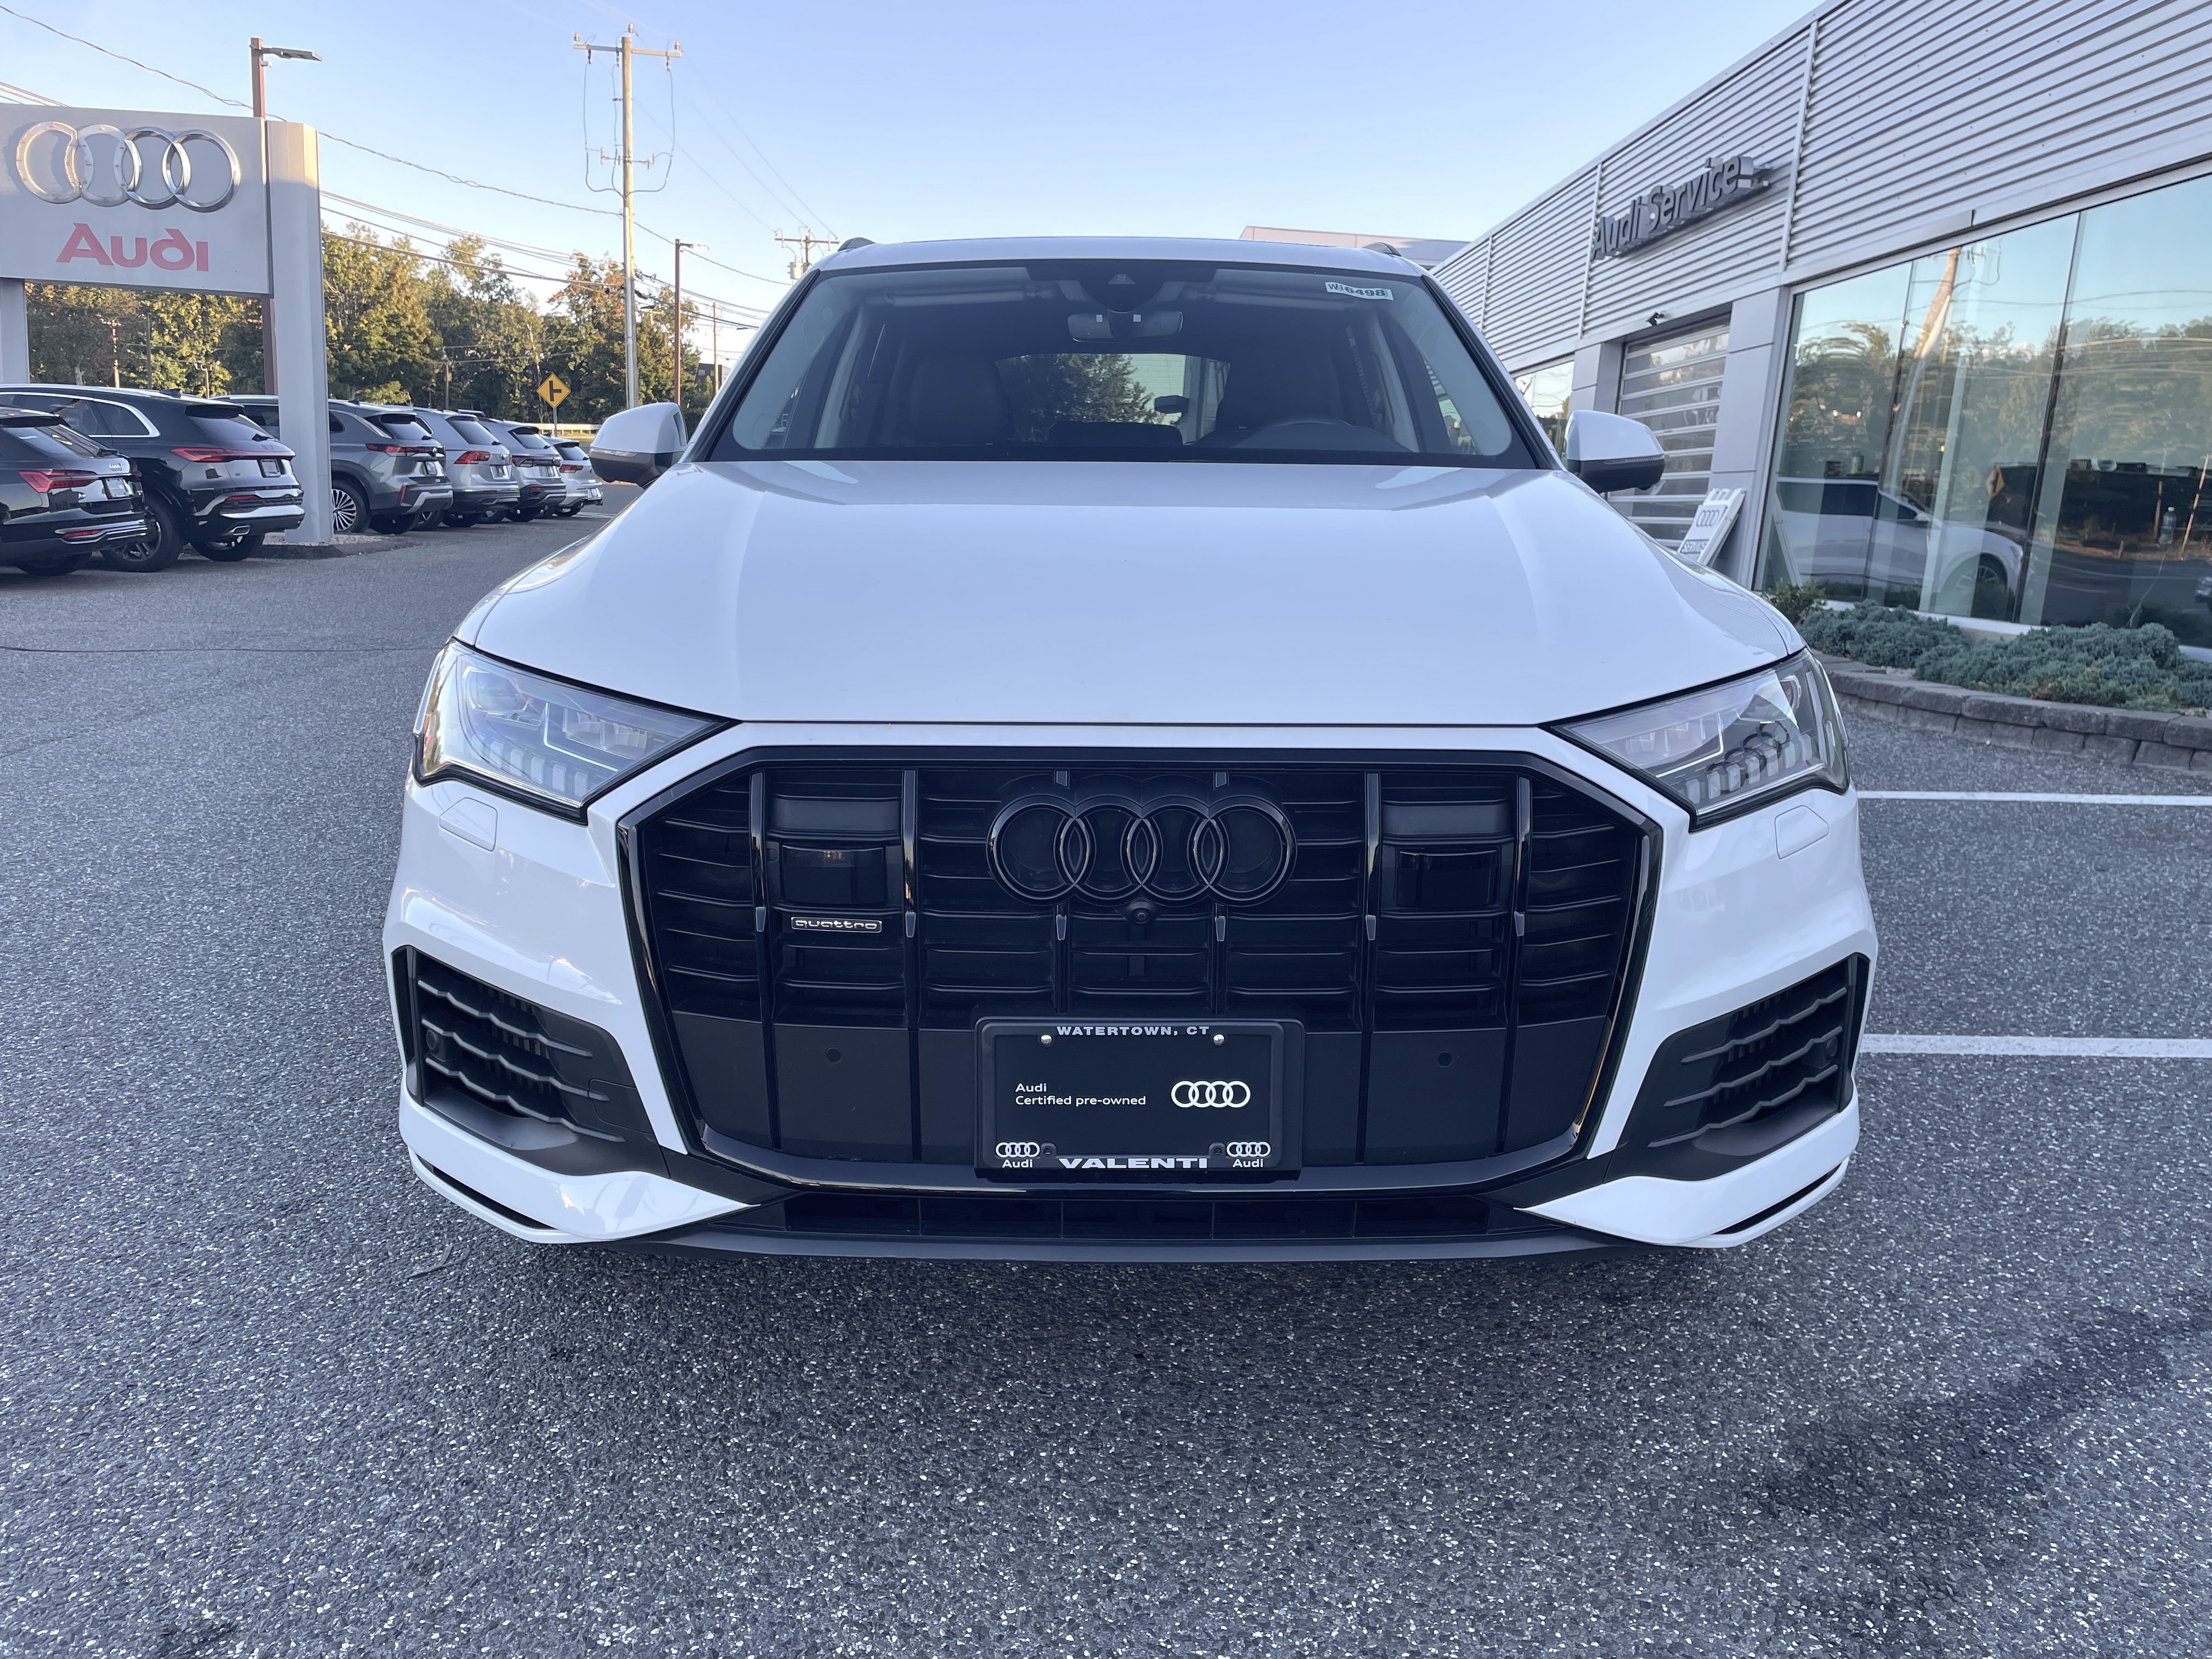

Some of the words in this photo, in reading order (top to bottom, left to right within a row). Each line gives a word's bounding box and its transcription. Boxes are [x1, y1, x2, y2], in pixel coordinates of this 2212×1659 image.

[1593, 194, 1647, 260] Audi
[1647, 156, 1743, 235] Service
[56, 222, 209, 272] Audi
[795, 919, 877, 929] quattro
[1057, 1026, 1178, 1036] WATERTOWN,
[1186, 1026, 1209, 1035] CT
[1015, 1083, 1047, 1092] Audi
[1015, 1095, 1071, 1105] Certified
[1076, 1096, 1146, 1107] pre-owned
[1002, 1159, 1033, 1168] Audi
[1058, 1158, 1207, 1169] VALENTI
[1232, 1158, 1263, 1167] Audi
